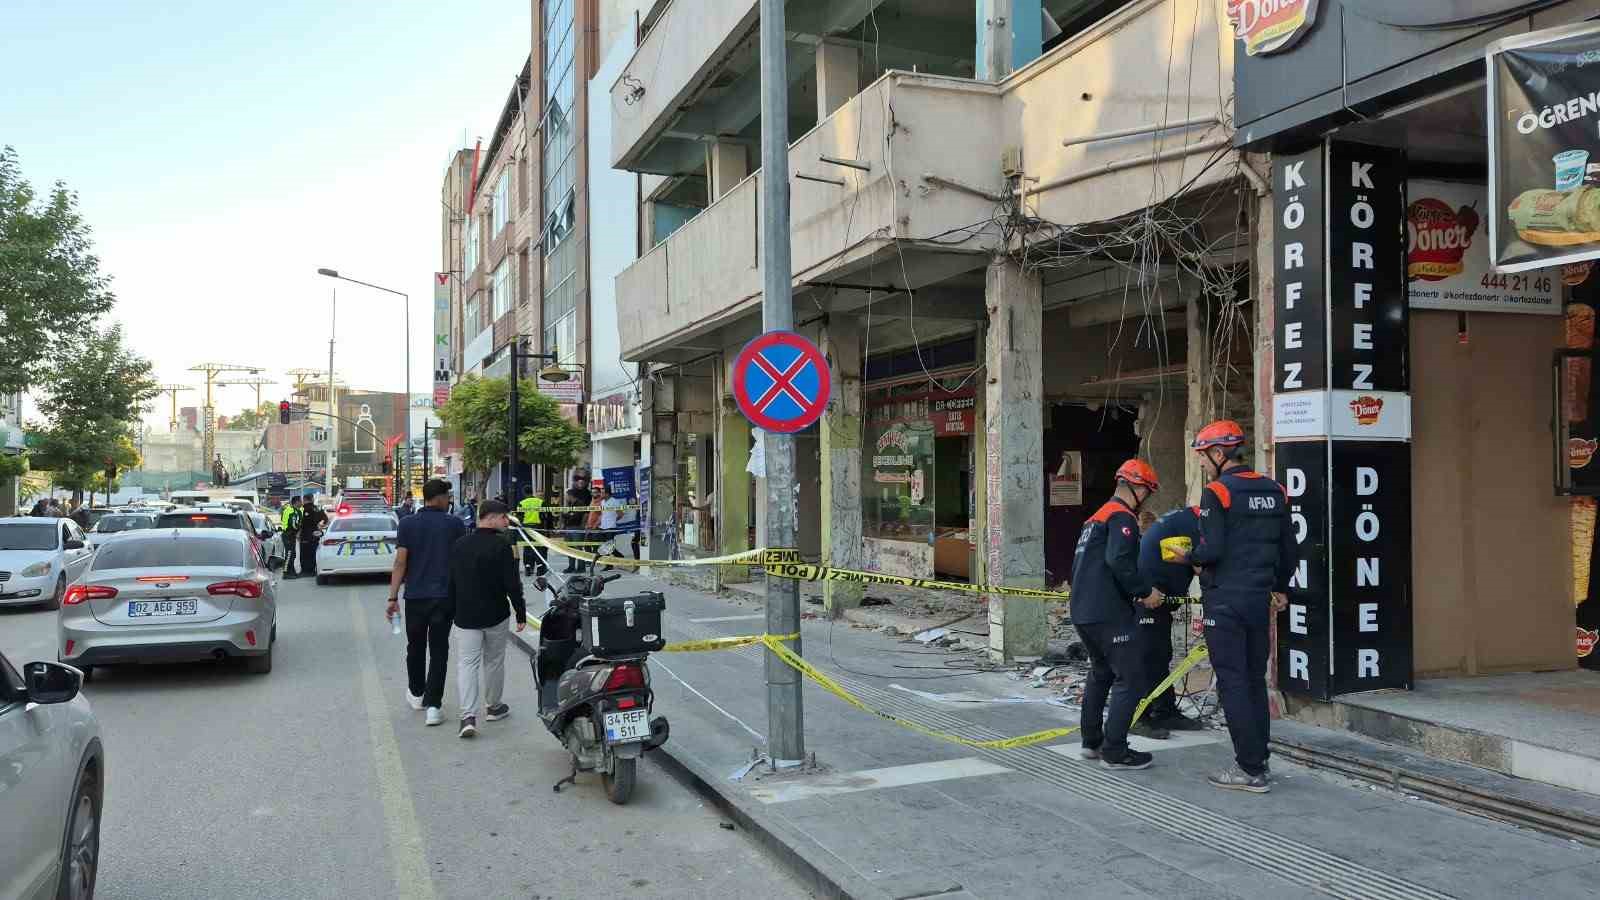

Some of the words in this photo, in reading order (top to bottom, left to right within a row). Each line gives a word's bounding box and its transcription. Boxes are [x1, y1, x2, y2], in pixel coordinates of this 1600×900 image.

[1283, 160, 1307, 389] KÖRFEZ
[1350, 161, 1375, 390] KÖRFEZ
[1481, 272, 1508, 290] 444
[1512, 275, 1529, 291] 21
[1534, 277, 1552, 292] 46
[1248, 496, 1275, 510] AFAD
[1355, 466, 1380, 679] DÖNER
[136, 603, 149, 612] 02
[154, 602, 173, 612] AEG
[176, 601, 195, 611] 959
[607, 715, 620, 726] 34
[623, 711, 645, 724] REF
[620, 726, 637, 737] 511
